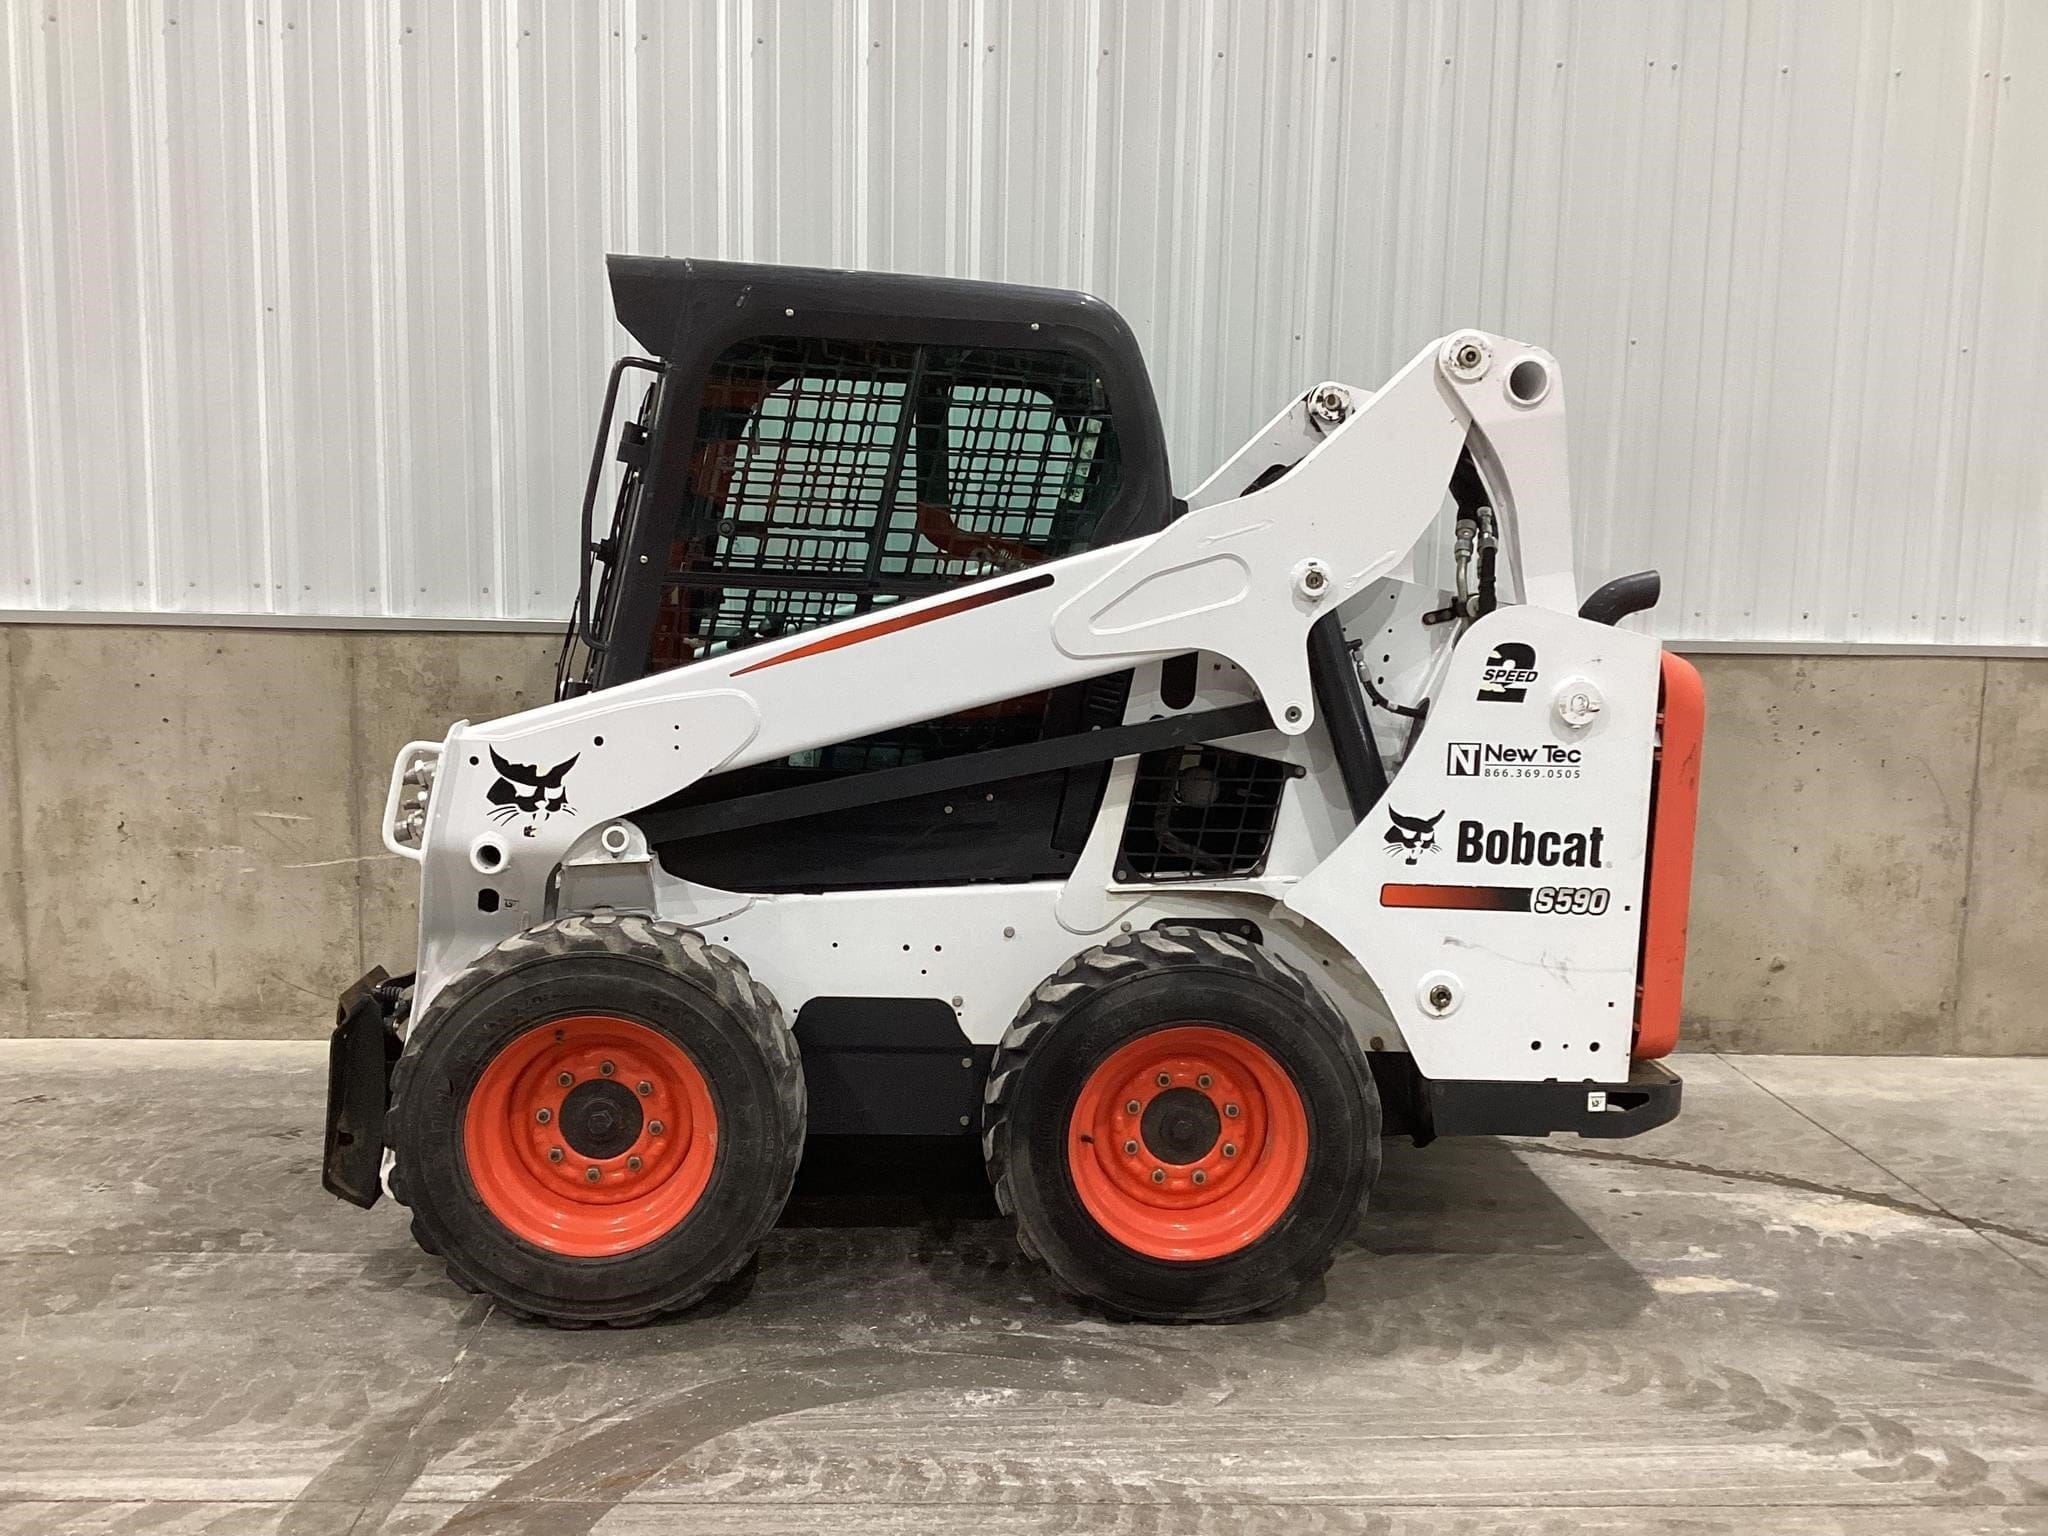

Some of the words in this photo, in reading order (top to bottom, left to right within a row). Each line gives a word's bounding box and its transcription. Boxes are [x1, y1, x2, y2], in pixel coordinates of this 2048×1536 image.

[1476, 642, 1536, 703] 2
[1482, 668, 1538, 683] SPEED
[1485, 744, 1538, 762] New
[1542, 745, 1581, 763] Tec
[1484, 768, 1581, 779] 866.369.0505
[1457, 820, 1604, 868] Bobcat
[1534, 886, 1610, 915] S590
